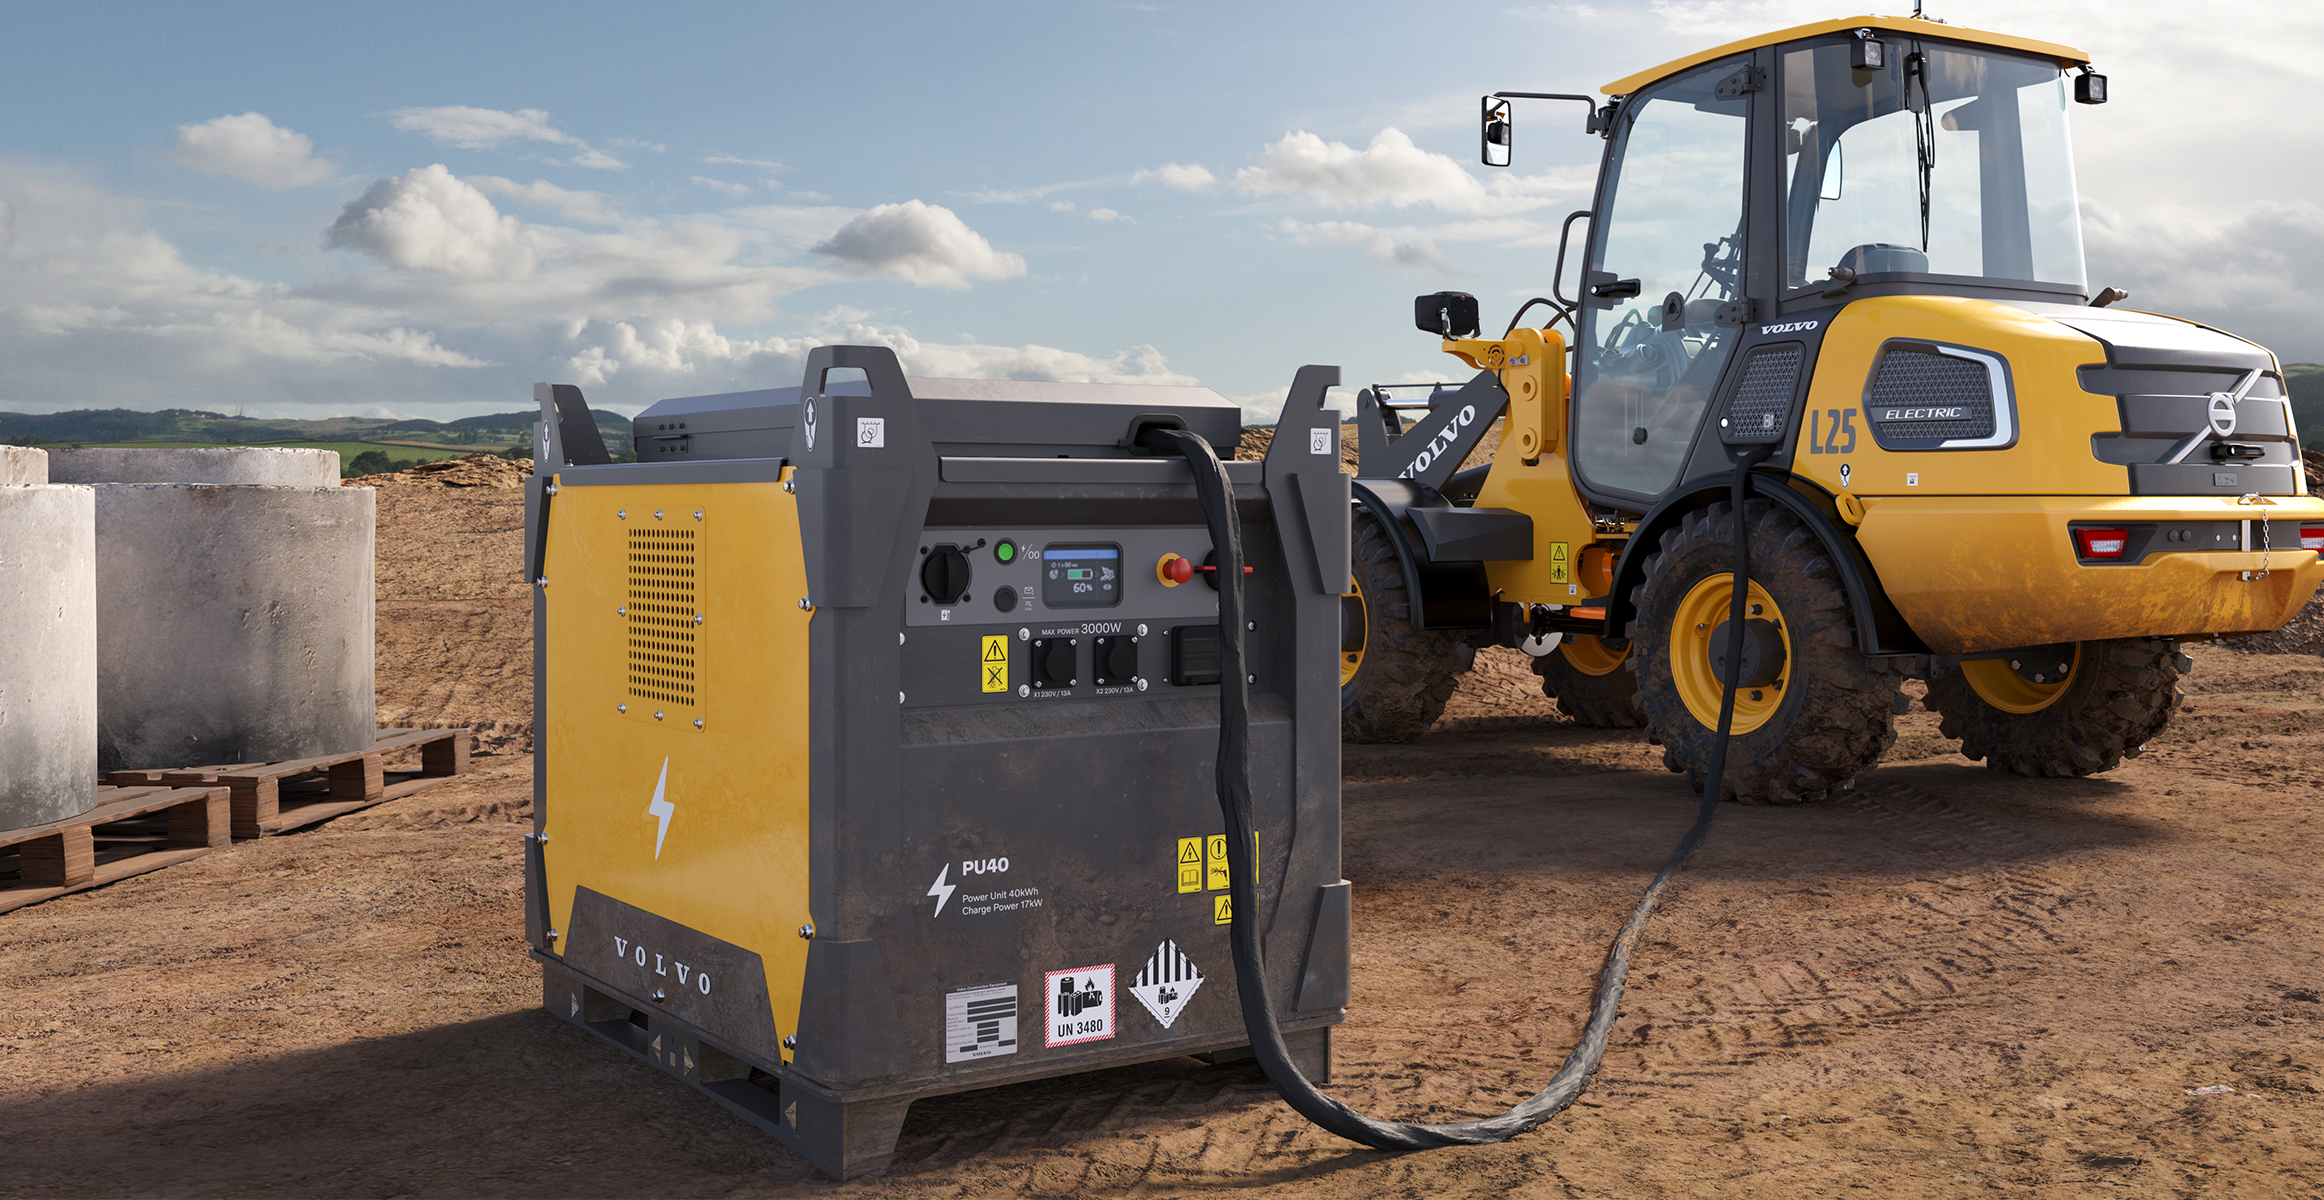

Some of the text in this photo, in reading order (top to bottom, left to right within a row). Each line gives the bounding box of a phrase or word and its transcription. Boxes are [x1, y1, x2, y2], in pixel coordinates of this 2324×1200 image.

[1761, 320, 1818, 335] VOLVO
[1885, 407, 1962, 420] ELECTRIC
[1810, 408, 1857, 454] L25
[1073, 582, 1093, 593] 60%
[1081, 622, 1122, 634] 3000W
[962, 857, 1009, 876] PU40
[962, 887, 1038, 903] Power Unit 40kWh
[962, 898, 1043, 915] Charge Power 17kW
[614, 936, 711, 995] VOLVO
[1164, 1007, 1170, 1016] 9
[1058, 1019, 1103, 1037] UN 3480
